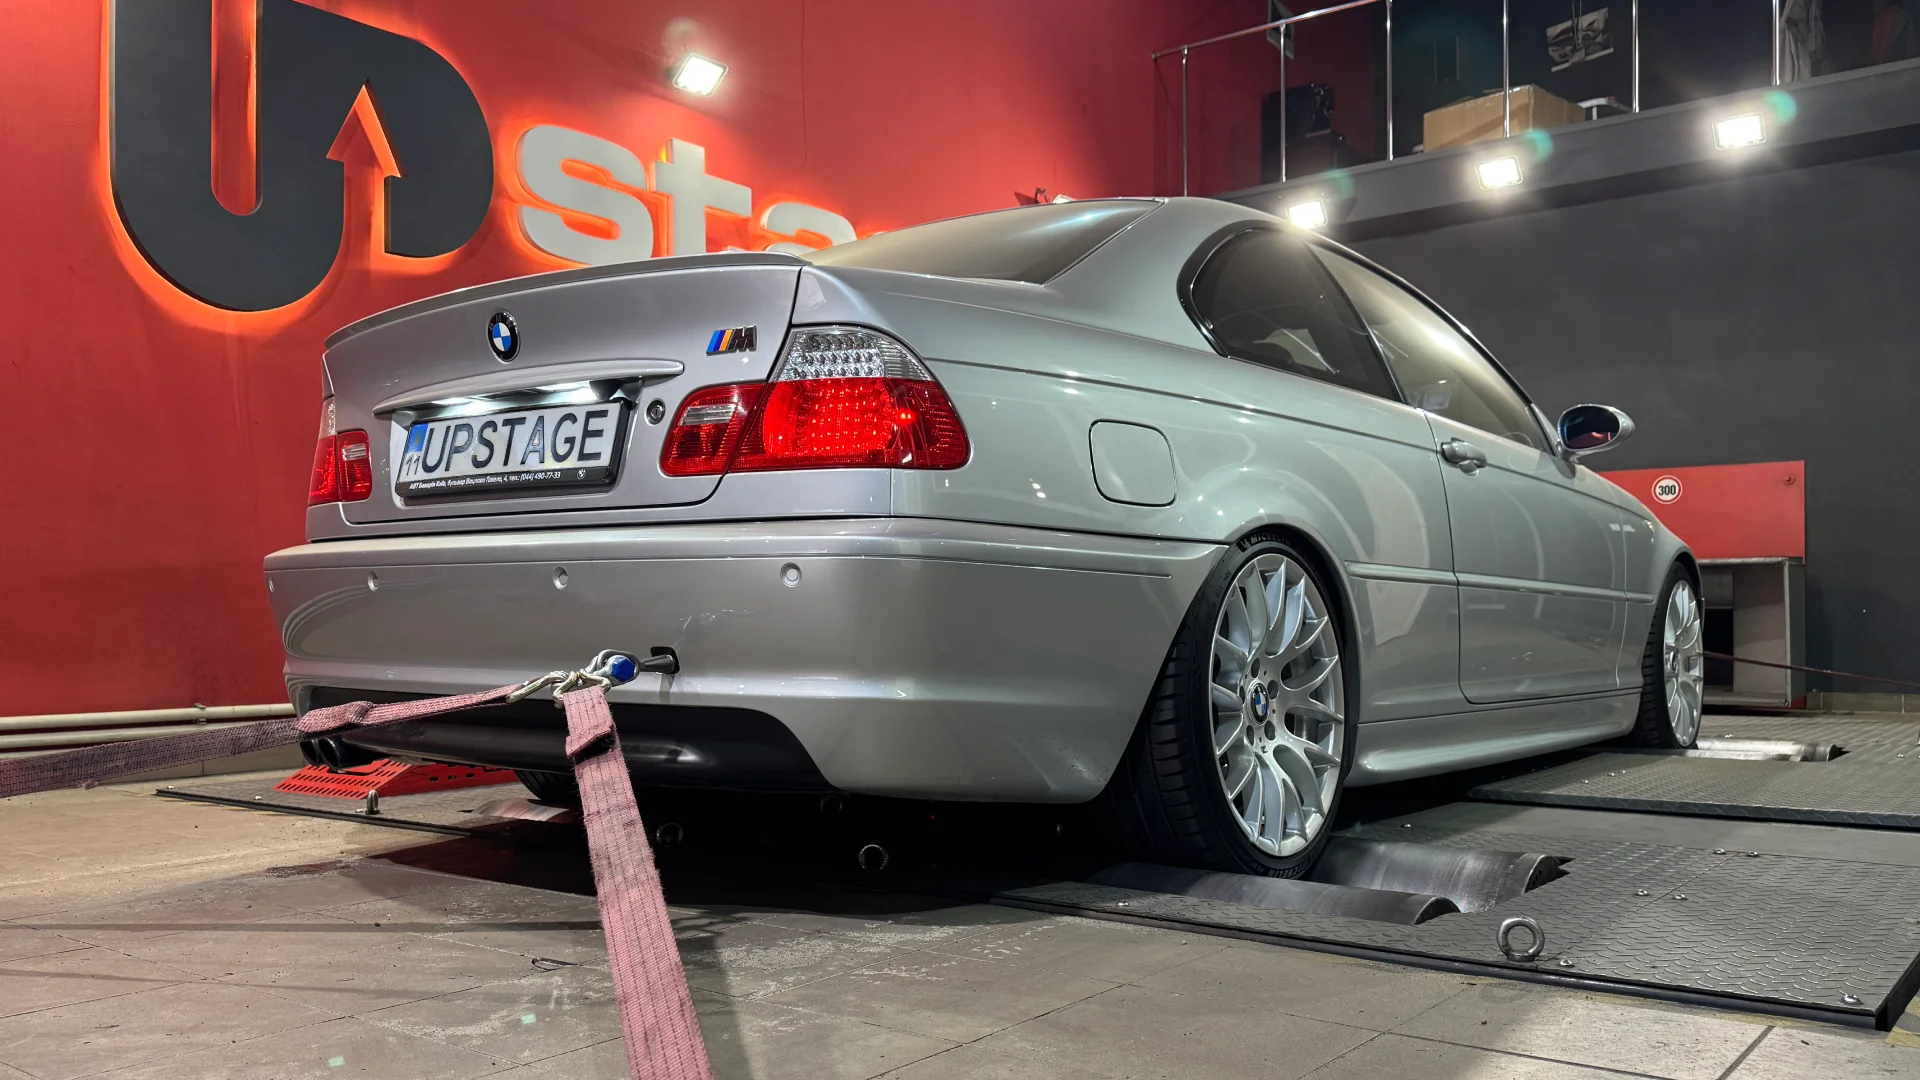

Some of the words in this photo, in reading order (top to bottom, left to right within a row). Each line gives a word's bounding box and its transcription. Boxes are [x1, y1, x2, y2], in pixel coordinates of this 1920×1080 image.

[725, 325, 758, 353] M
[422, 410, 609, 474] UPSTAGE
[404, 454, 421, 476] 11
[520, 472, 534, 482] (044)
[534, 471, 561, 480] 490-77-33
[1659, 485, 1676, 496] 300
[1250, 531, 1291, 546] MICHELIN
